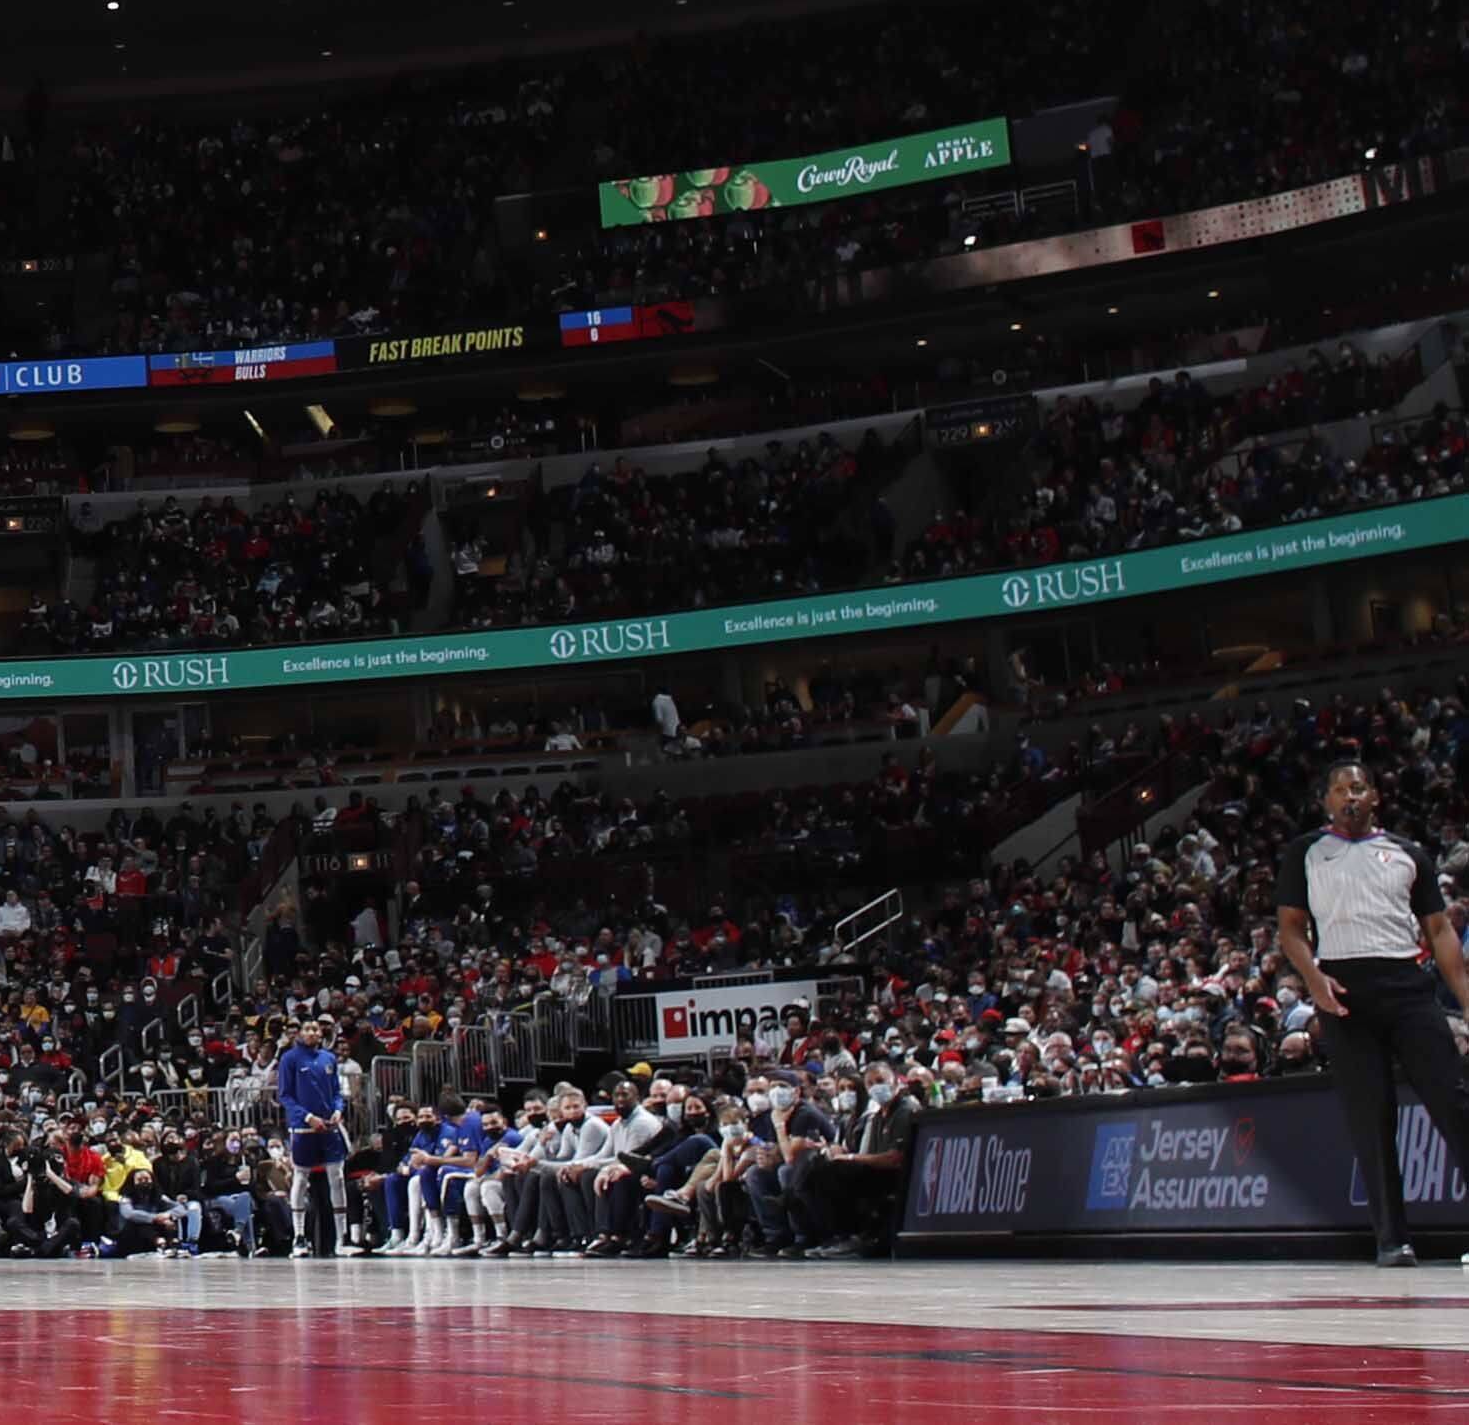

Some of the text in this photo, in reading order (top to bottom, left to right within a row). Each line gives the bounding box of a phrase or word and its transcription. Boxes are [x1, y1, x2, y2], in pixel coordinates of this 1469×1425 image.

[924, 140, 993, 168] APPLE
[937, 137, 975, 149] REGAL
[235, 346, 287, 363] WARRIORS
[369, 327, 523, 363] FAST BREAK POINTS
[16, 363, 82, 386] CLUB
[235, 364, 267, 380] BULLS
[1141, 1121, 1230, 1171] Jersey
[935, 1135, 1032, 1214] NBA Store
[1129, 1172, 1269, 1210] Assurance
